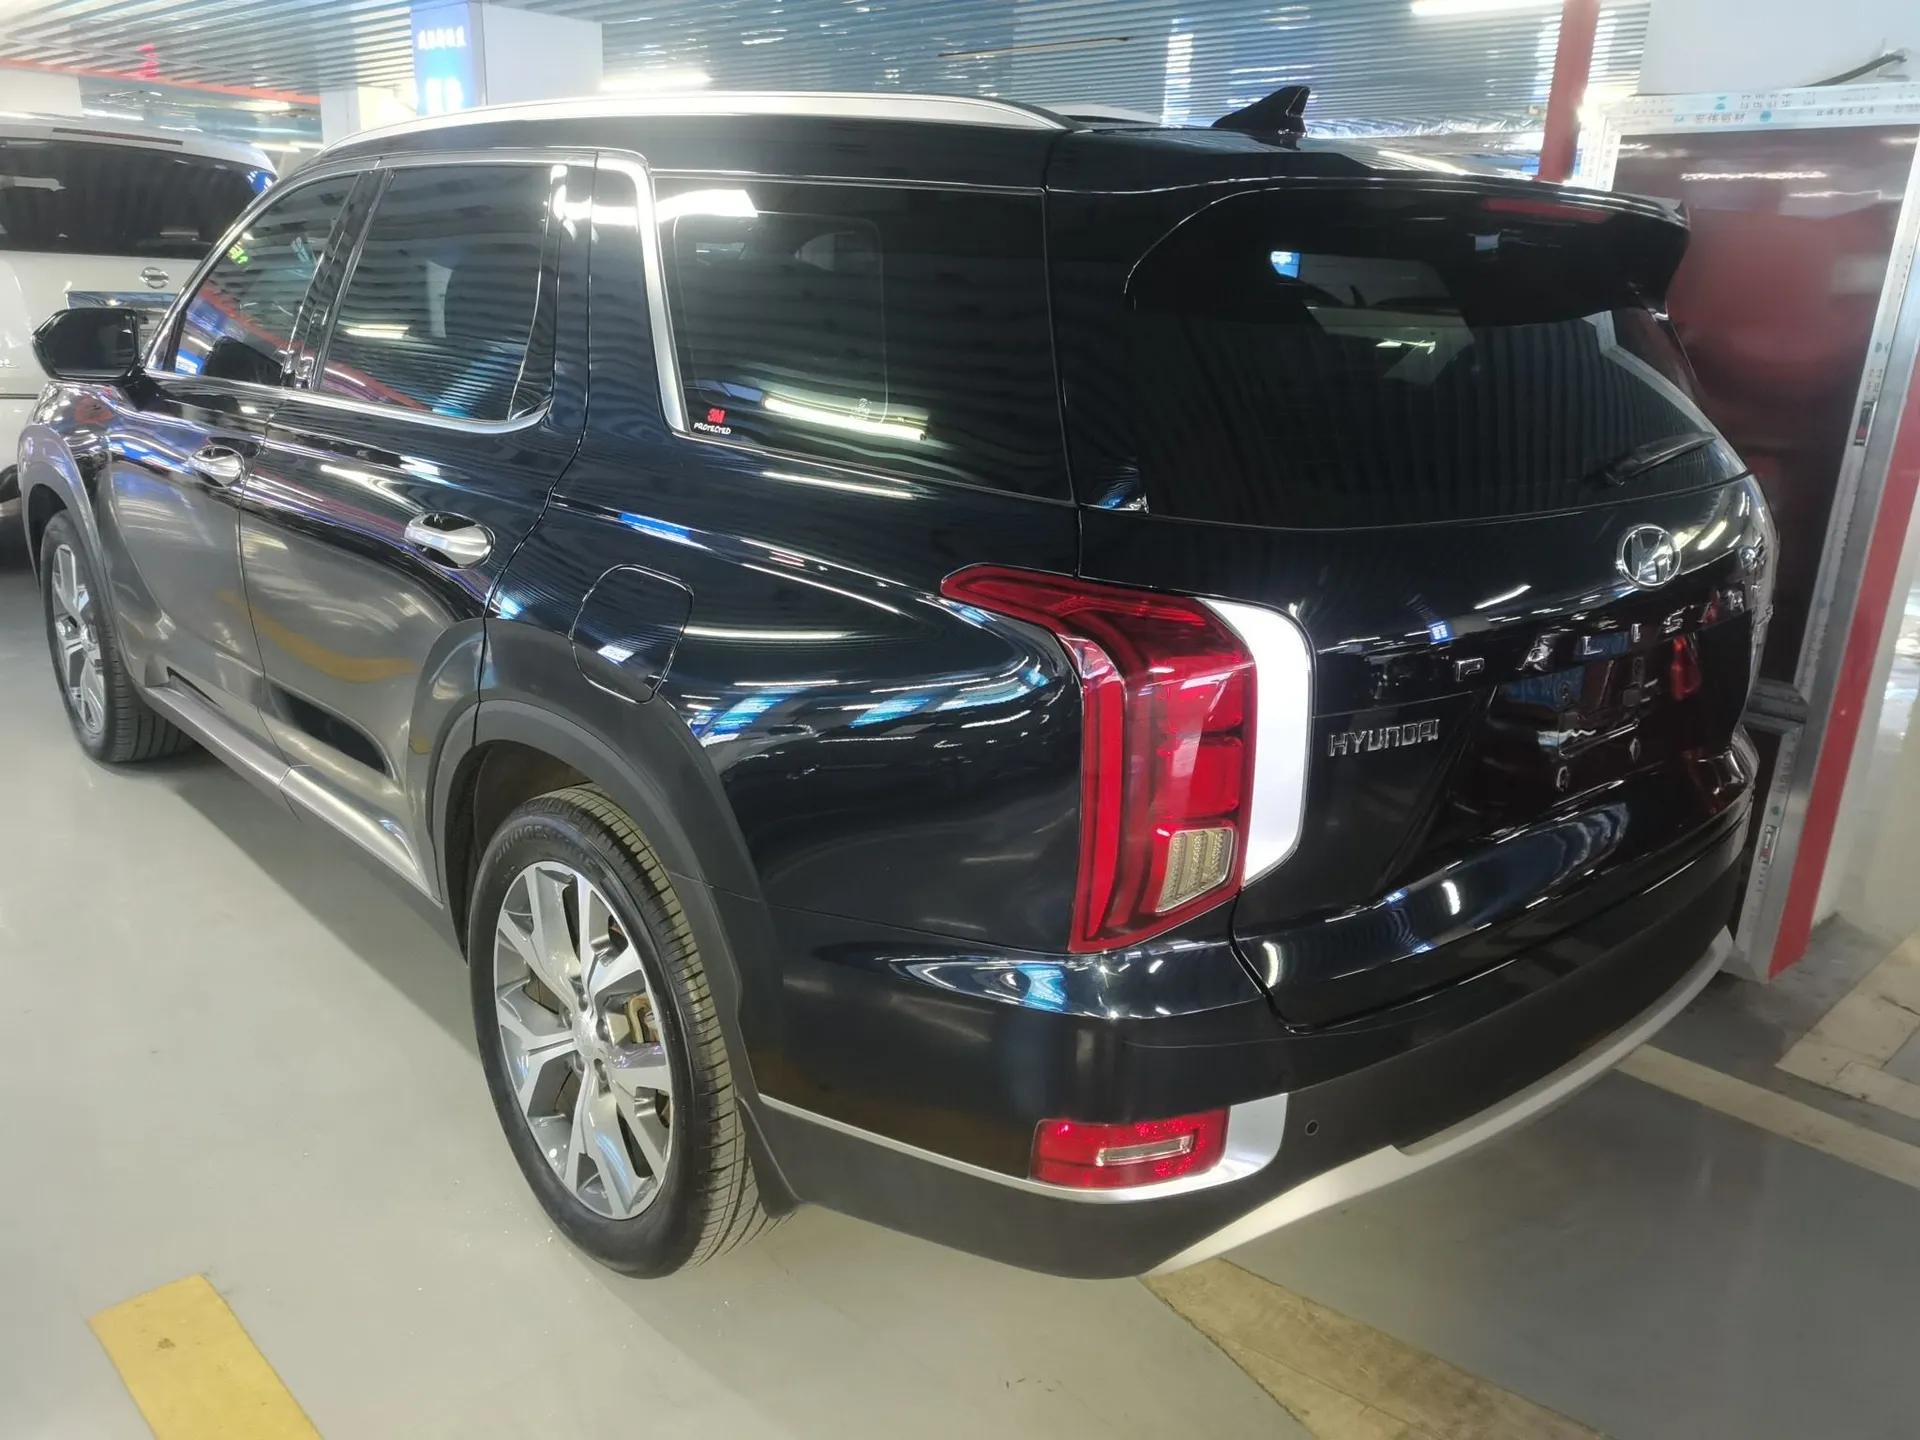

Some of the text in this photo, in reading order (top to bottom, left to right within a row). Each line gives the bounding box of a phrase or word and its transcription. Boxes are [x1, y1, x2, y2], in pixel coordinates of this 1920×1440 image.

[707, 408, 726, 424] 3M
[693, 422, 732, 435] PROTECTED
[1329, 719, 1440, 757] HYUNDAI
